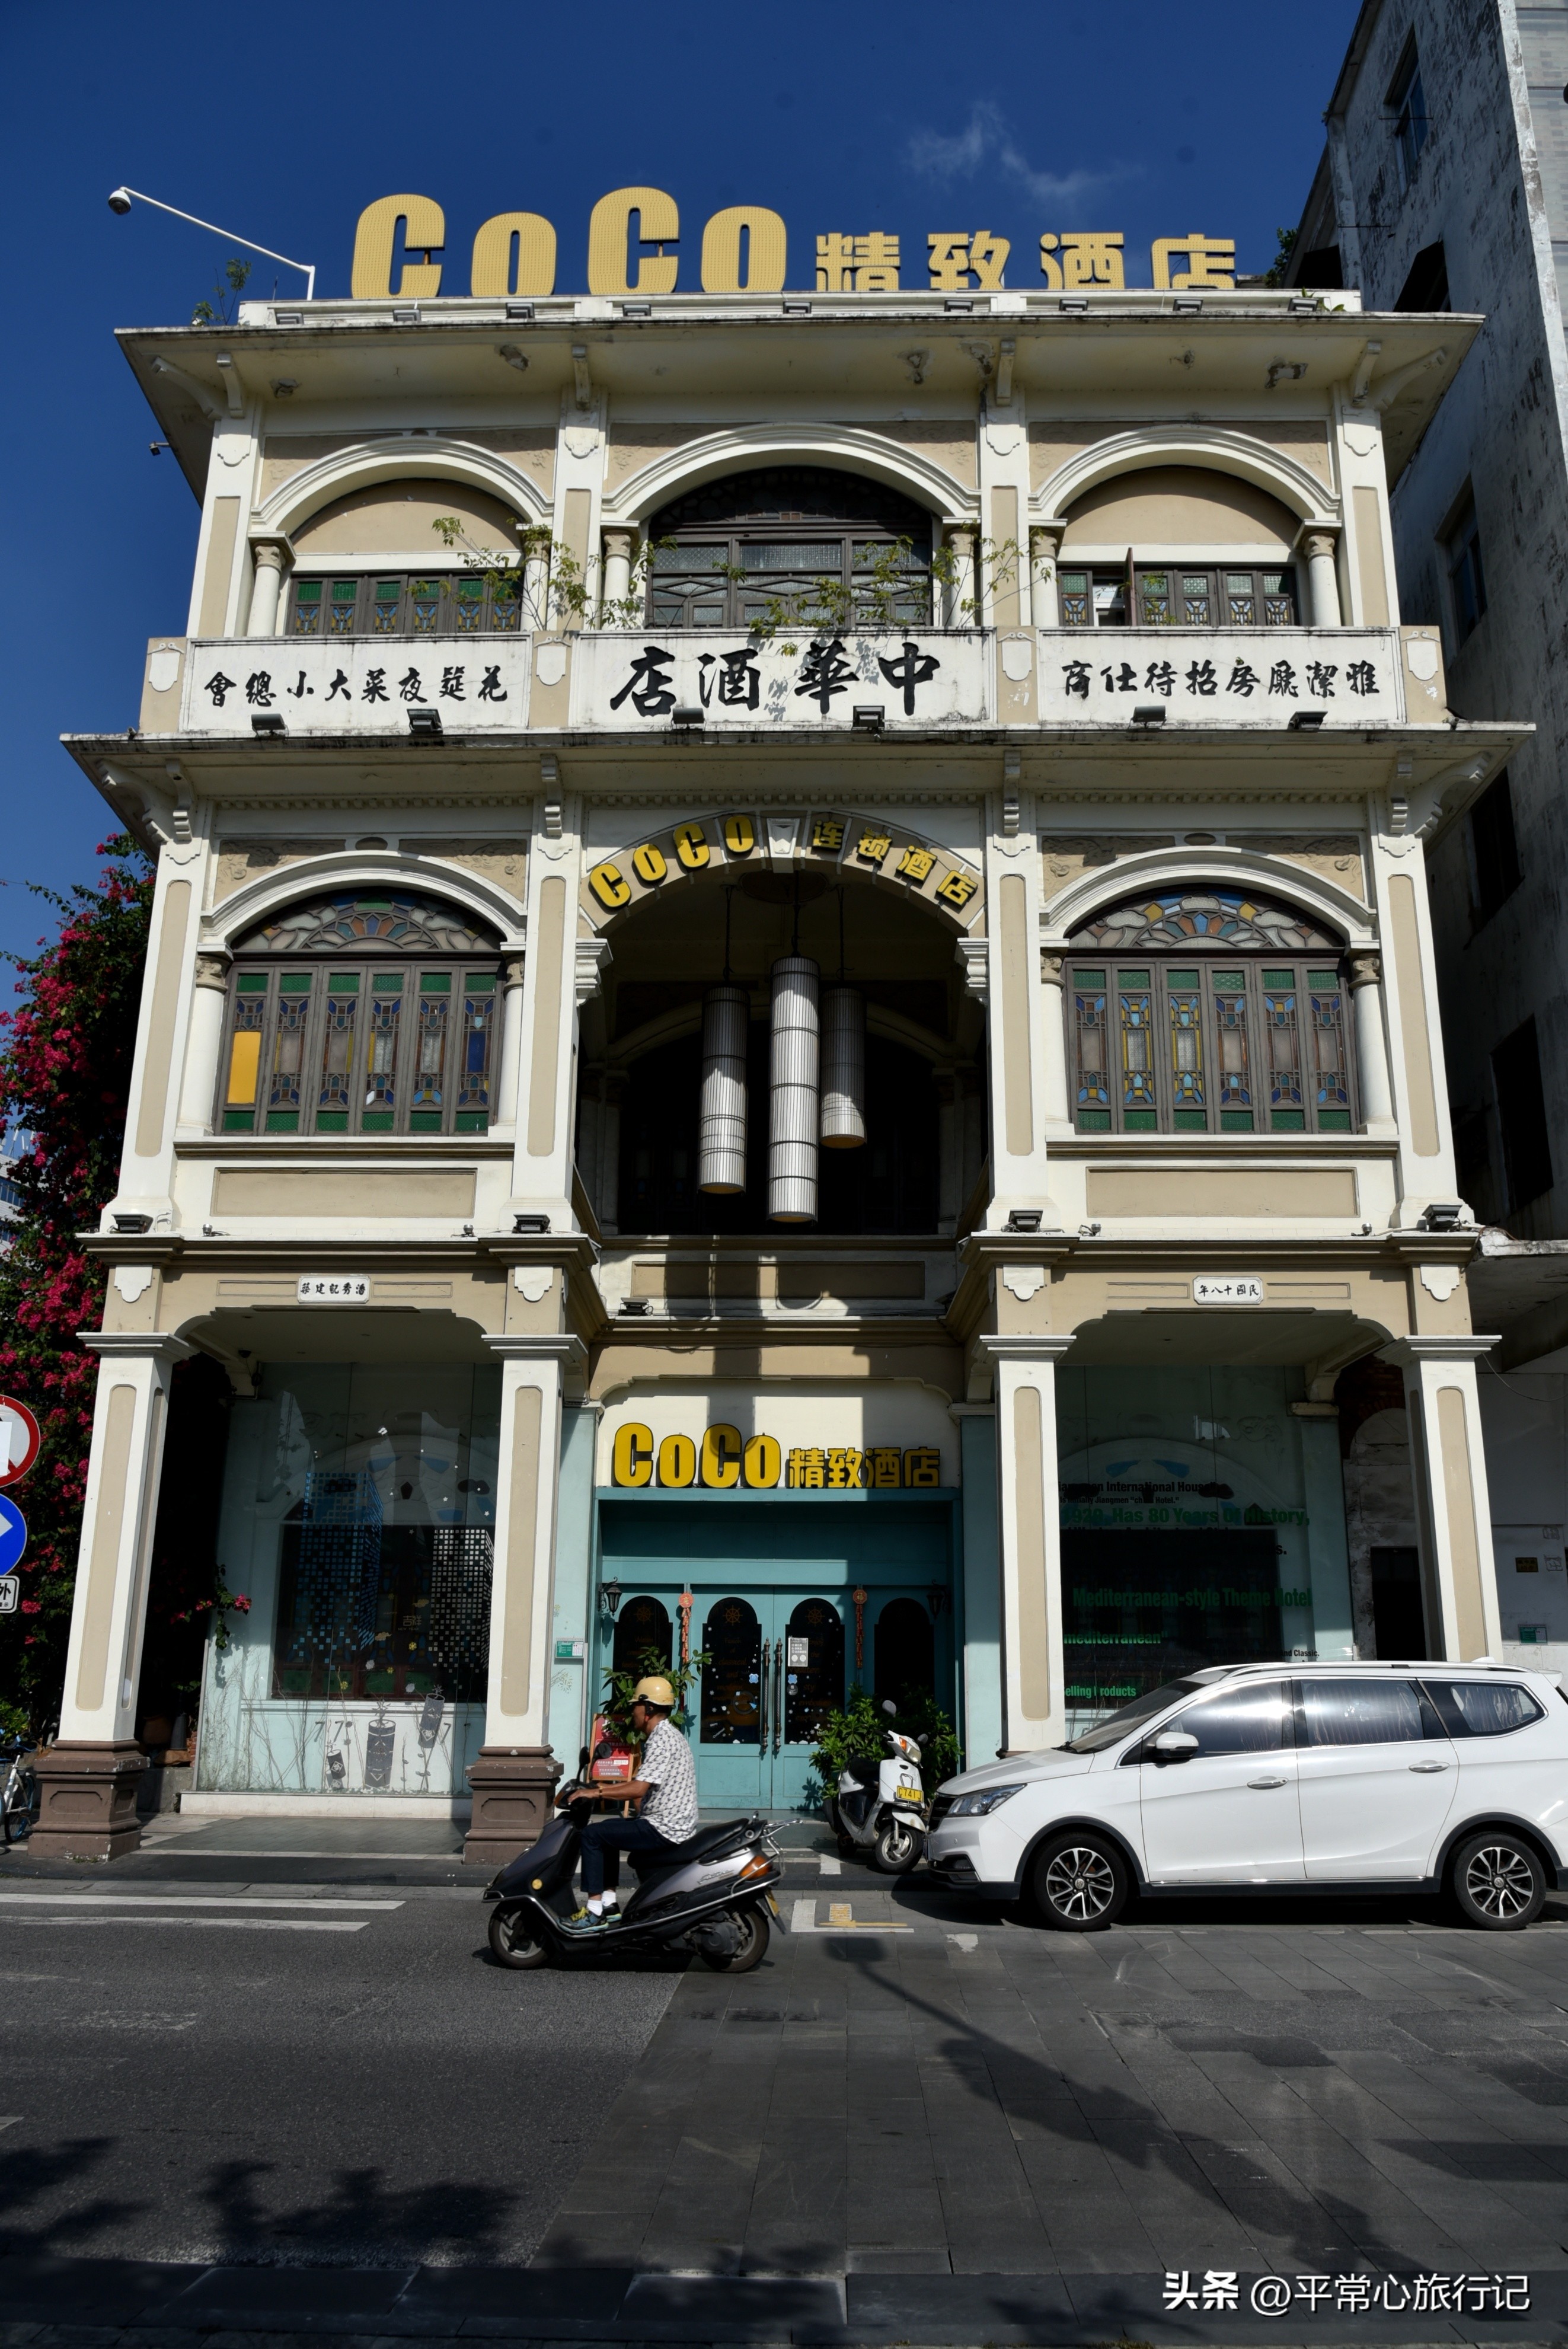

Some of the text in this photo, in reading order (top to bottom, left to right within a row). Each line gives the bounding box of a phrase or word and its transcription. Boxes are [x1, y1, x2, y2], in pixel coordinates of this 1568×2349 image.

[816, 231, 1235, 291] 精致酒店
[610, 640, 941, 717] 中華酒店
[813, 820, 979, 907] 连锁酒店
[1198, 1284, 1259, 1297] 民國十八年
[789, 1447, 940, 1488] 精致酒店
[1112, 1508, 1143, 1523] Has
[1148, 1508, 1170, 1523] 80
[1173, 1508, 1219, 1523] Years
[1221, 1587, 1271, 1607] Theme
